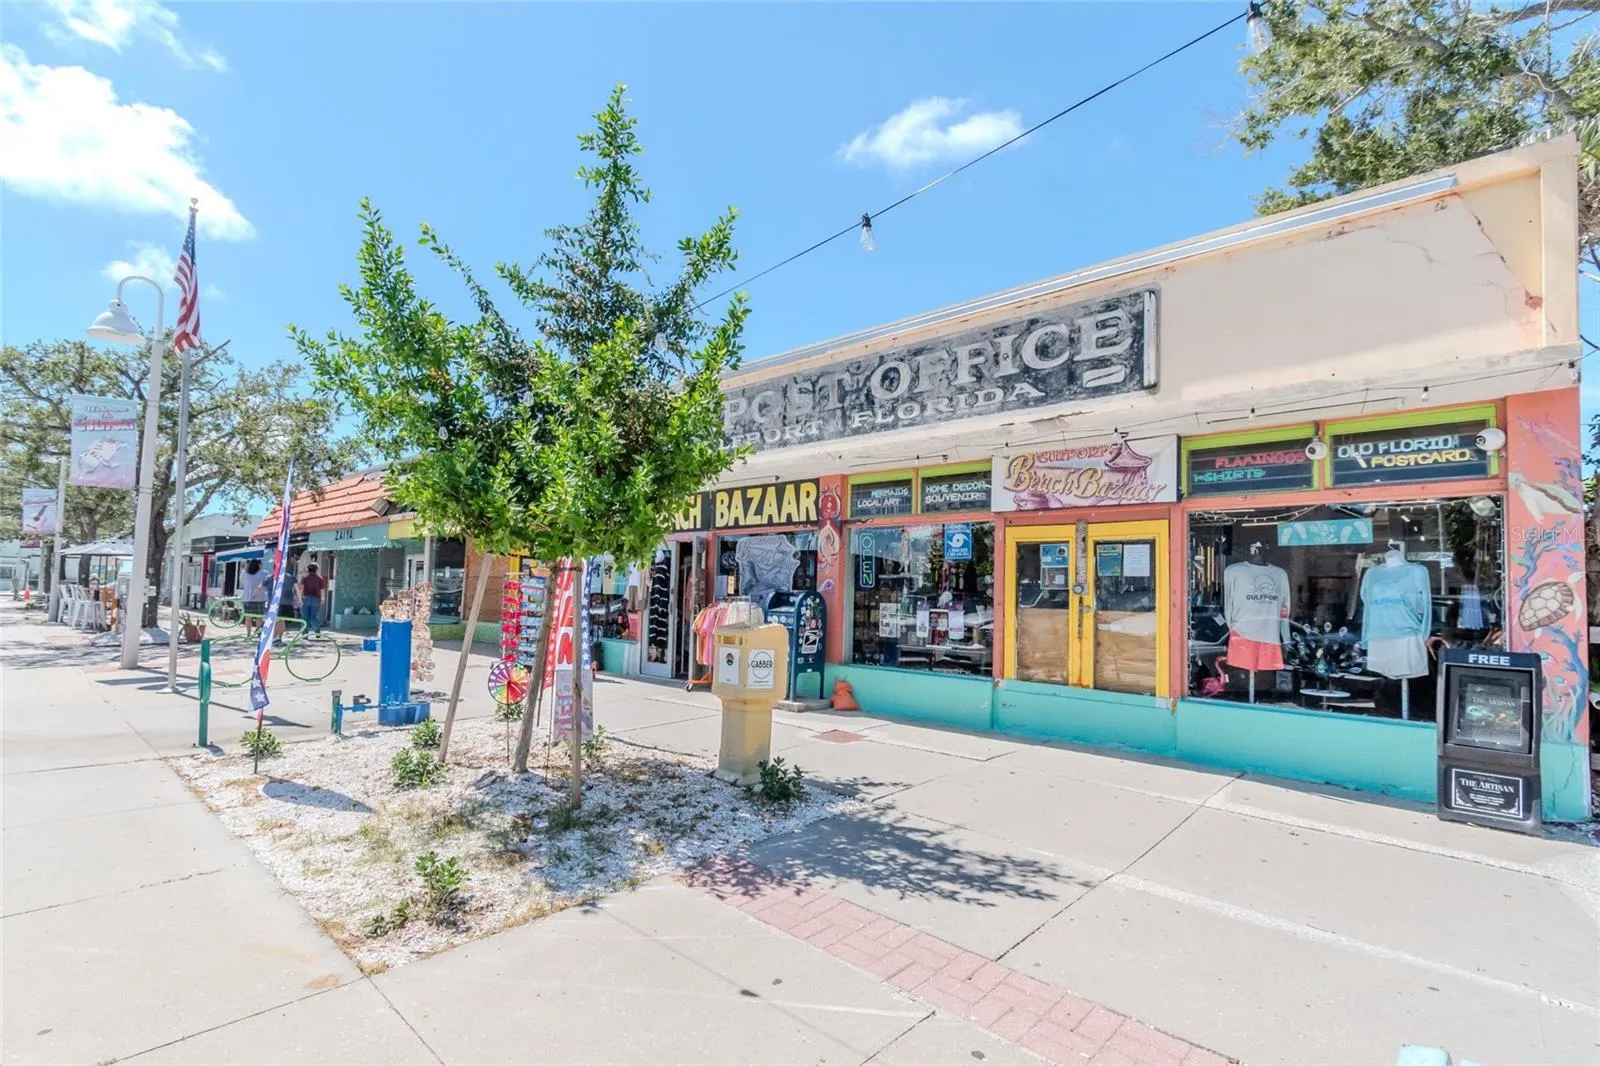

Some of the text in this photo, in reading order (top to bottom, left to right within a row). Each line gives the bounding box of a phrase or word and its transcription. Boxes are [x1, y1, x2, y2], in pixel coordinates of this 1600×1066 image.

[870, 308, 1134, 402] OFFICE
[719, 382, 1047, 450] LFPORT FLORIDA
[1337, 434, 1461, 458] OLD FLORIDA
[1215, 449, 1307, 469] FLAMINGOS
[1003, 454, 1075, 494] Beach
[925, 480, 986, 494] HOME DECOR
[715, 481, 818, 528] BAZAAR
[857, 497, 902, 508] LOCAL ART
[925, 491, 987, 504] SOUVENIRS
[750, 660, 773, 669] GABBER
[1468, 654, 1511, 666] FREE
[1460, 777, 1477, 788] THE
[1479, 780, 1515, 793] ARTISAN
